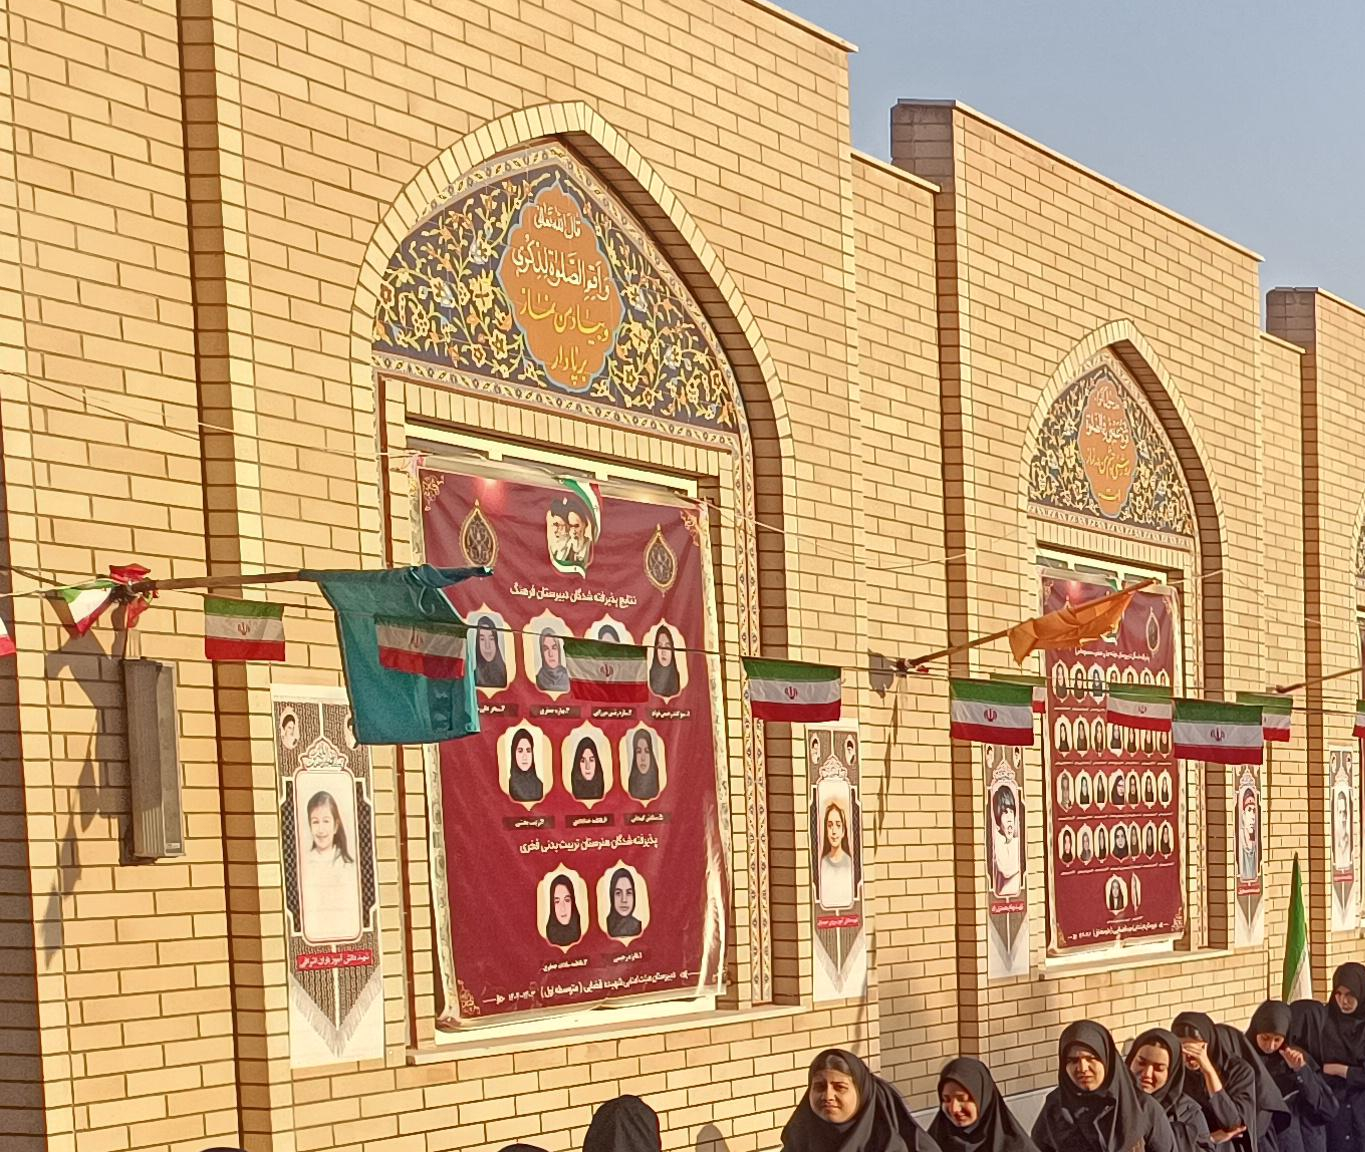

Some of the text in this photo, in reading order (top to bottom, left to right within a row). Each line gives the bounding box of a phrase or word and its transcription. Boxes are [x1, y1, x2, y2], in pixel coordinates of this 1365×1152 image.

[509, 581, 536, 599] فرهنگ
[536, 586, 569, 602] دبیرستان
[619, 594, 637, 609] نتایج
